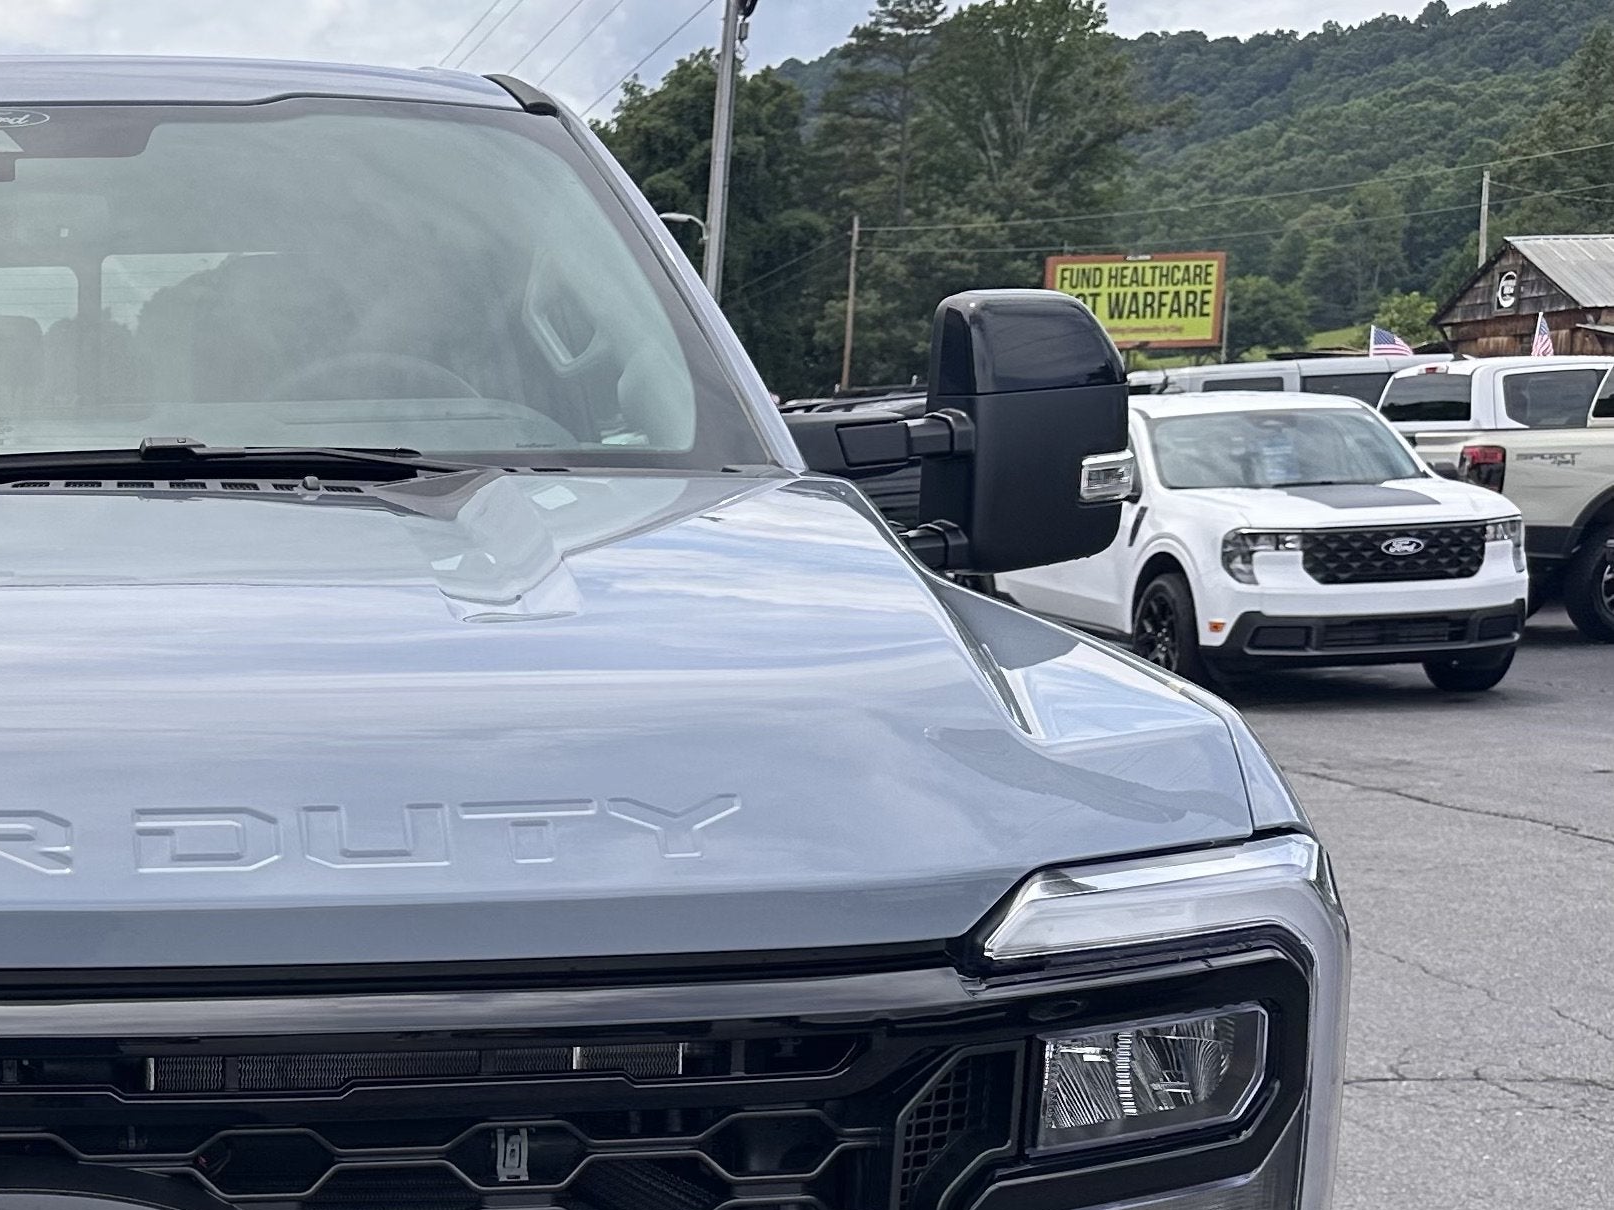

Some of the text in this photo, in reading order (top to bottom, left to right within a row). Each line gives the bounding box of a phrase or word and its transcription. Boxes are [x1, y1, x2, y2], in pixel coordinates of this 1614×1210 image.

[1059, 264, 1214, 289] FUND HEALTHCARE
[1108, 290, 1213, 320] WARFARE
[133, 793, 741, 873] DUTY
